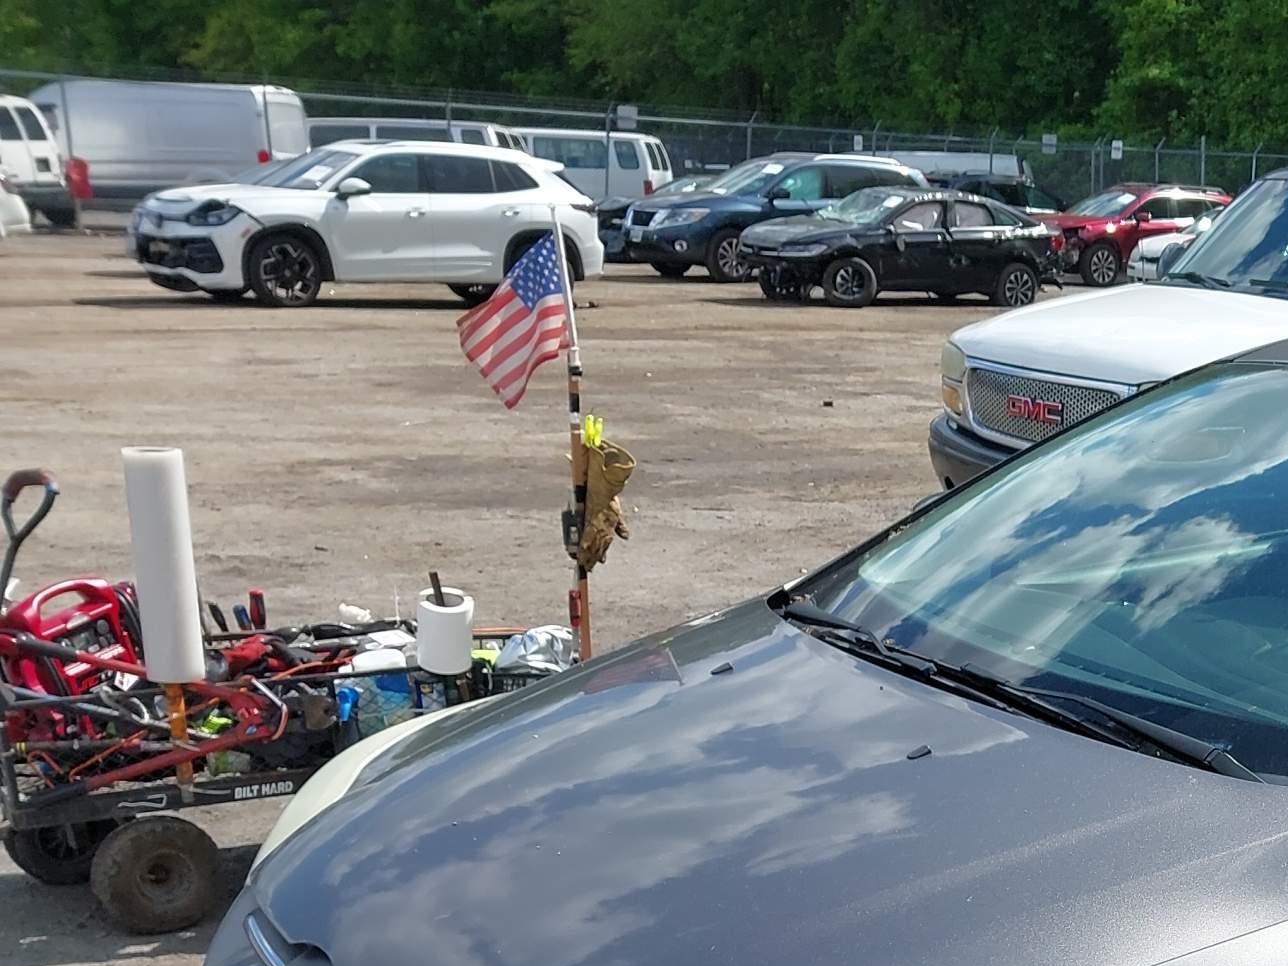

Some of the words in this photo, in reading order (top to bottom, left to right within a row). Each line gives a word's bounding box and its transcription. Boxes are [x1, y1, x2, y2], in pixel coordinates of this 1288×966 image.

[1008, 394, 1062, 424] GMC
[234, 784, 260, 800] BILT
[261, 781, 294, 796] HARD
